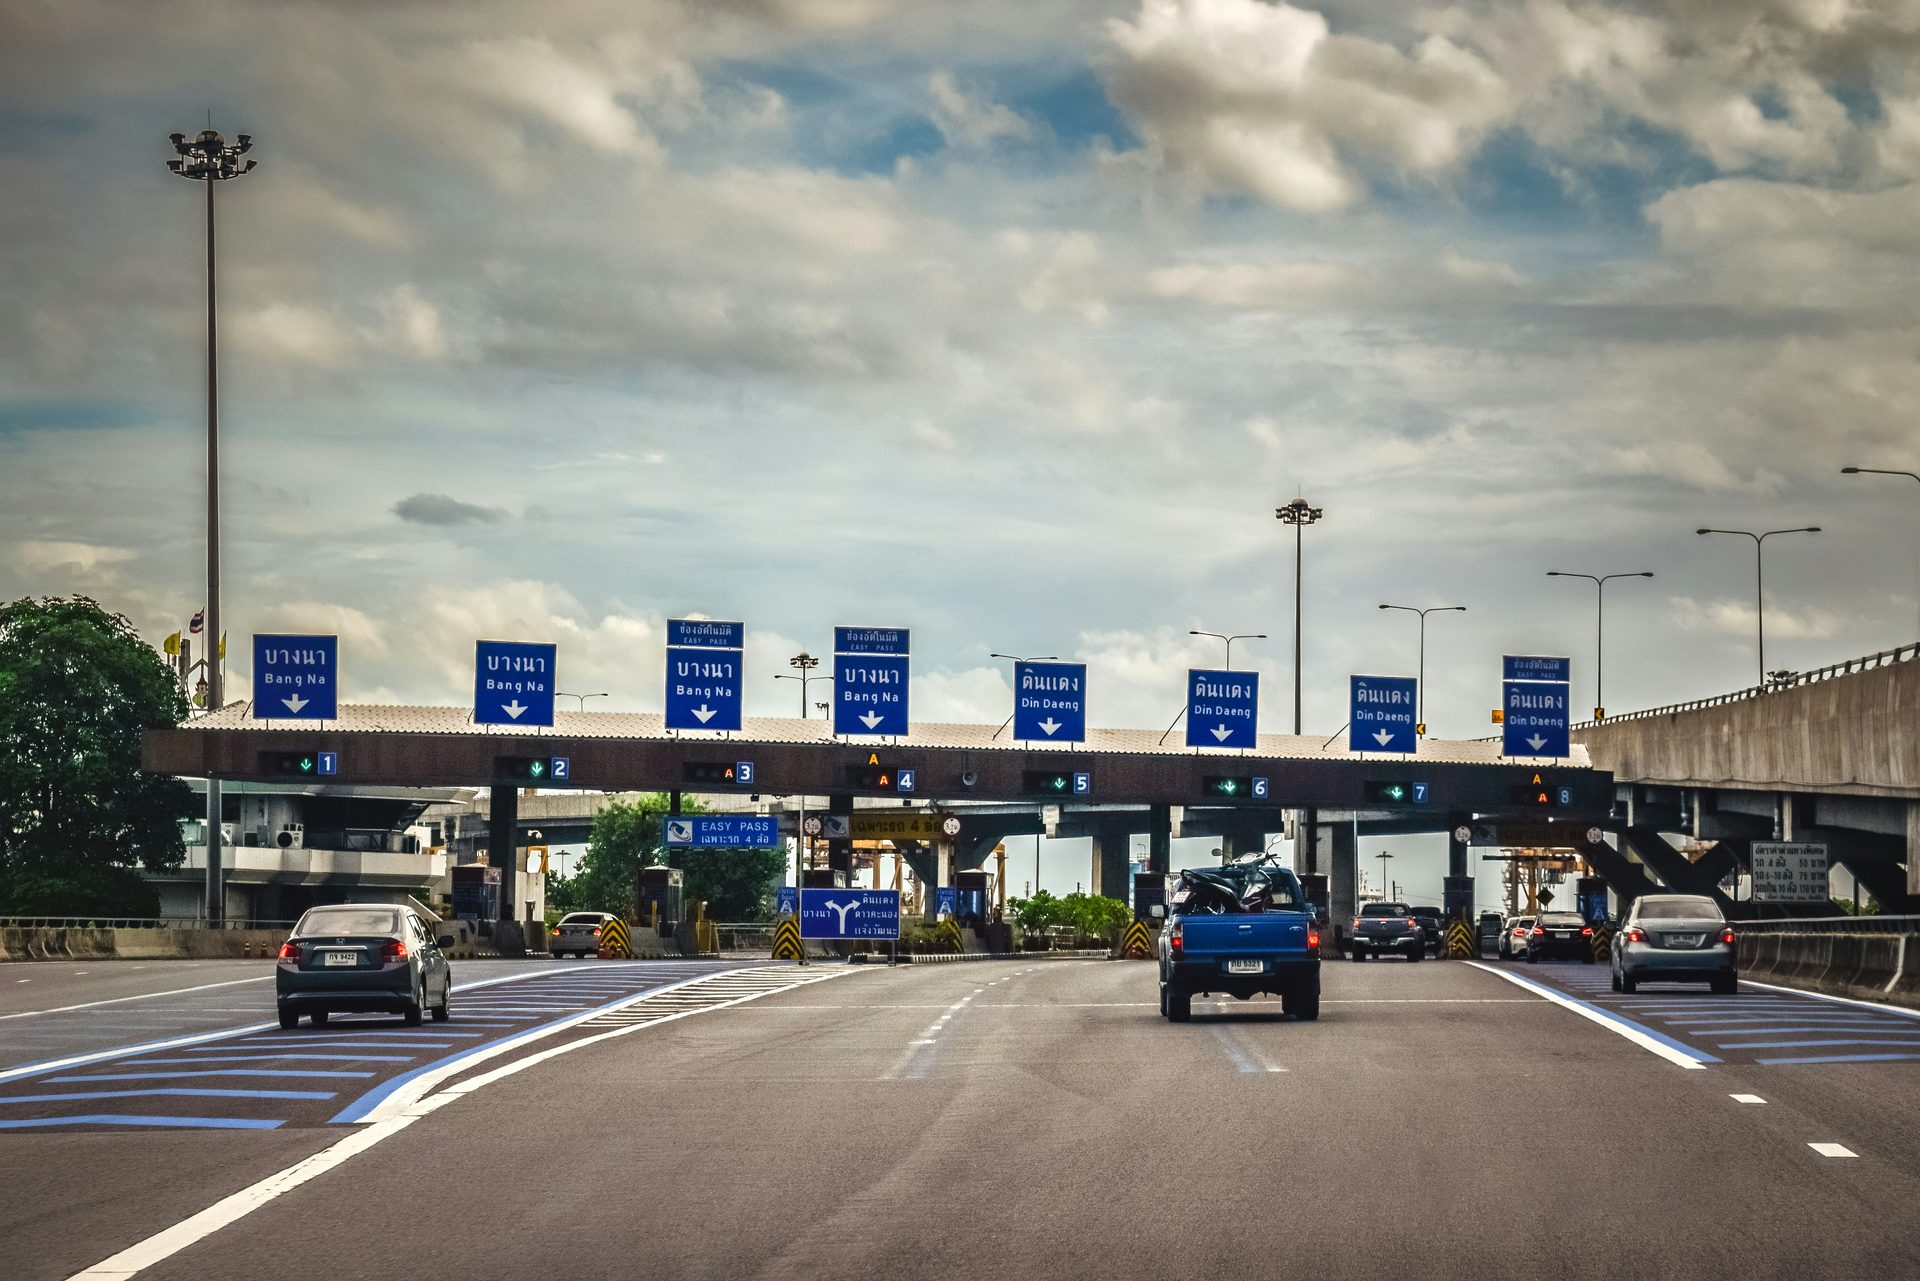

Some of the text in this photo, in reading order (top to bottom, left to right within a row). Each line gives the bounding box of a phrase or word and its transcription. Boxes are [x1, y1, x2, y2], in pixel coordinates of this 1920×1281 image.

[683, 637, 728, 646] EASY PASS
[265, 650, 325, 664] บางนา
[488, 656, 544, 672] บางนา
[678, 662, 731, 678] บางนา
[846, 669, 898, 683] บางนา
[265, 673, 325, 686] Bang Na
[487, 679, 543, 693] Bang Na
[1022, 668, 1078, 691] ดินแดง
[677, 685, 731, 698] Bang Na
[1196, 675, 1251, 699] ดินแดง
[1358, 682, 1409, 704] ดินแดง
[845, 691, 898, 704] Bang Na
[1022, 697, 1078, 712] Din Daeng
[1511, 688, 1562, 708] ดินแดง
[1195, 705, 1250, 719] Din Daeng
[1357, 710, 1410, 724] Din Daeng
[1510, 714, 1563, 728] Din Daeng
[324, 756, 331, 771] 1
[869, 754, 878, 764] A
[555, 761, 566, 776] 2
[725, 769, 733, 777] A
[741, 765, 751, 780] 3
[880, 776, 888, 784] A
[900, 774, 912, 788] 4
[1077, 777, 1087, 790] 5
[1533, 774, 1541, 784] A
[1255, 782, 1265, 795] 6
[1416, 786, 1425, 800] 7
[1539, 793, 1547, 802] A
[1561, 790, 1569, 804] 8
[702, 822, 768, 831] EASY PASS
[911, 822, 918, 831] 4
[701, 836, 739, 844] เฉพาะรถ
[757, 833, 769, 844] ล้อ
[780, 900, 793, 912] A
[939, 901, 952, 913] A
[803, 910, 831, 918] บางนา
